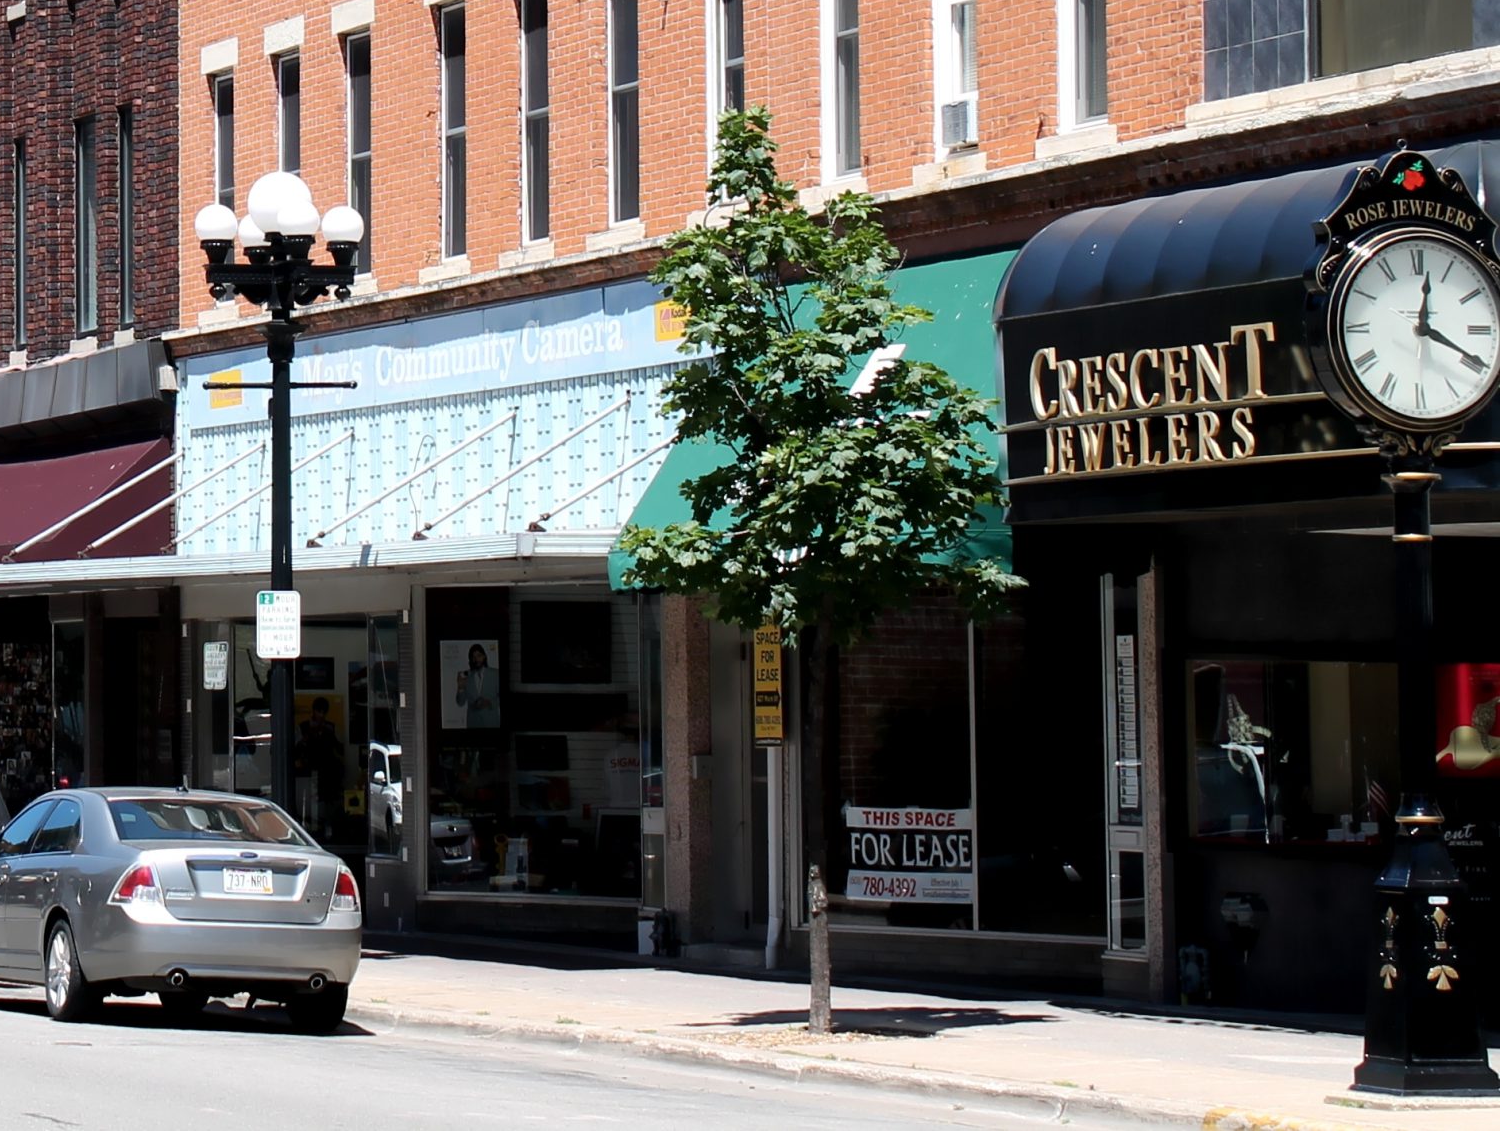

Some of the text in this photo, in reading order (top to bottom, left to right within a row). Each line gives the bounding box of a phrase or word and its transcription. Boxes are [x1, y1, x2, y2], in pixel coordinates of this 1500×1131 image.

[1344, 199, 1476, 233] ROSE JEWELERS
[375, 328, 516, 387] Community
[521, 318, 624, 365] Camera
[1030, 322, 1275, 420] CRESCENT
[1044, 407, 1256, 475] JEWELERS
[756, 632, 779, 645] SPACE
[760, 650, 775, 663] FOR
[756, 668, 779, 681] LEASE
[862, 811, 956, 827] THIS SPACE
[850, 832, 972, 867] FOR LEASE
[862, 876, 917, 898] 780-4392
